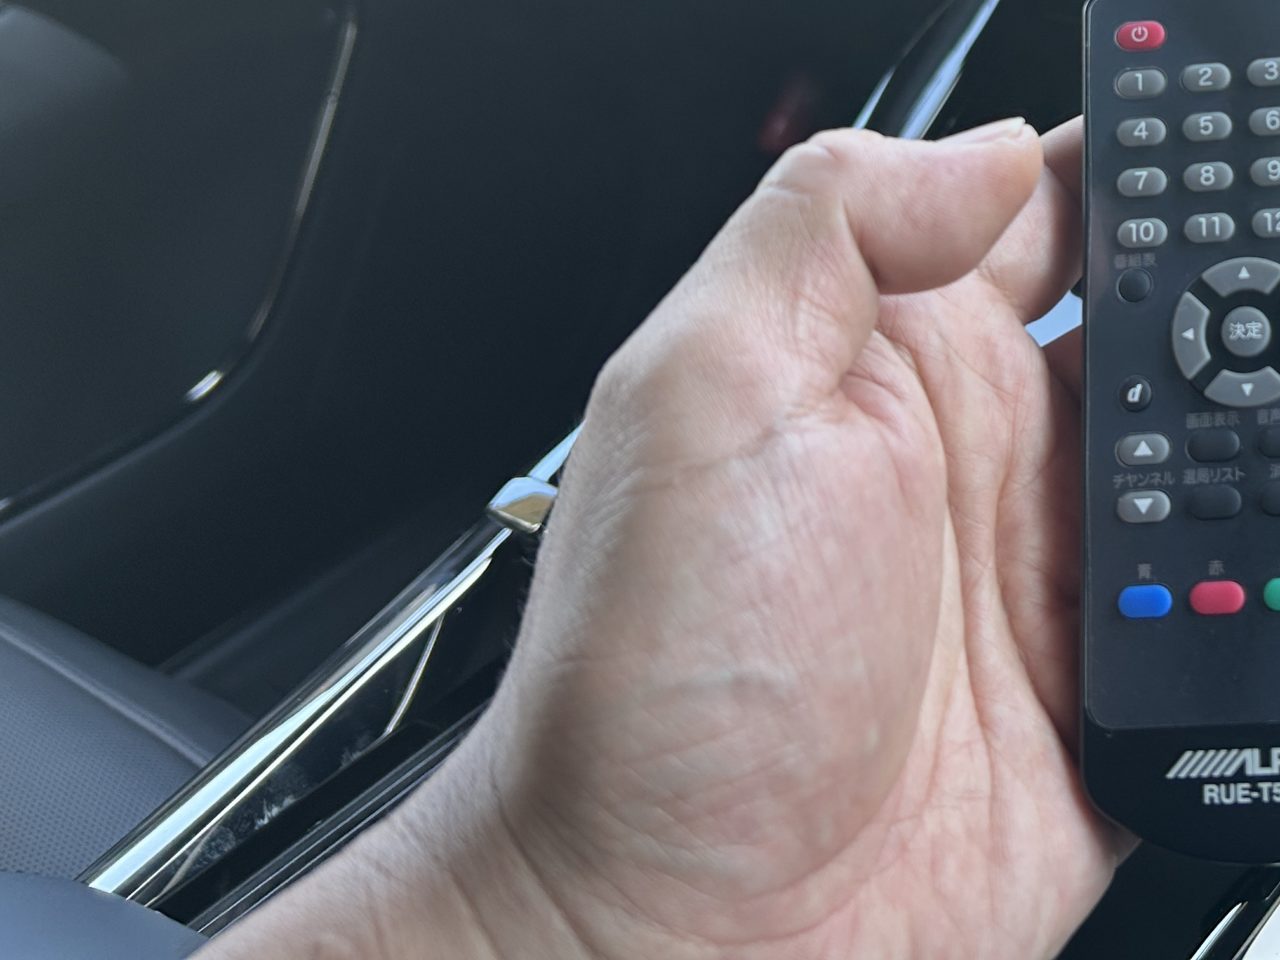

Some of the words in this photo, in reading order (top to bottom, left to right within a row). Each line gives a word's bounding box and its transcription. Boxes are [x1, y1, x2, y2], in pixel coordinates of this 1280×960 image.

[1198, 67, 1213, 86] 2
[1263, 61, 1279, 81] 3
[1134, 73, 1144, 91] 1
[1199, 116, 1213, 136] 5
[1265, 110, 1280, 130] 6
[1133, 121, 1149, 140] 4
[1134, 171, 1149, 191] 7
[1200, 165, 1215, 186] 8
[1127, 222, 1155, 243] 10
[1197, 216, 1221, 237] 11
[1229, 321, 1263, 339] 決定
[1127, 384, 1143, 404] d
